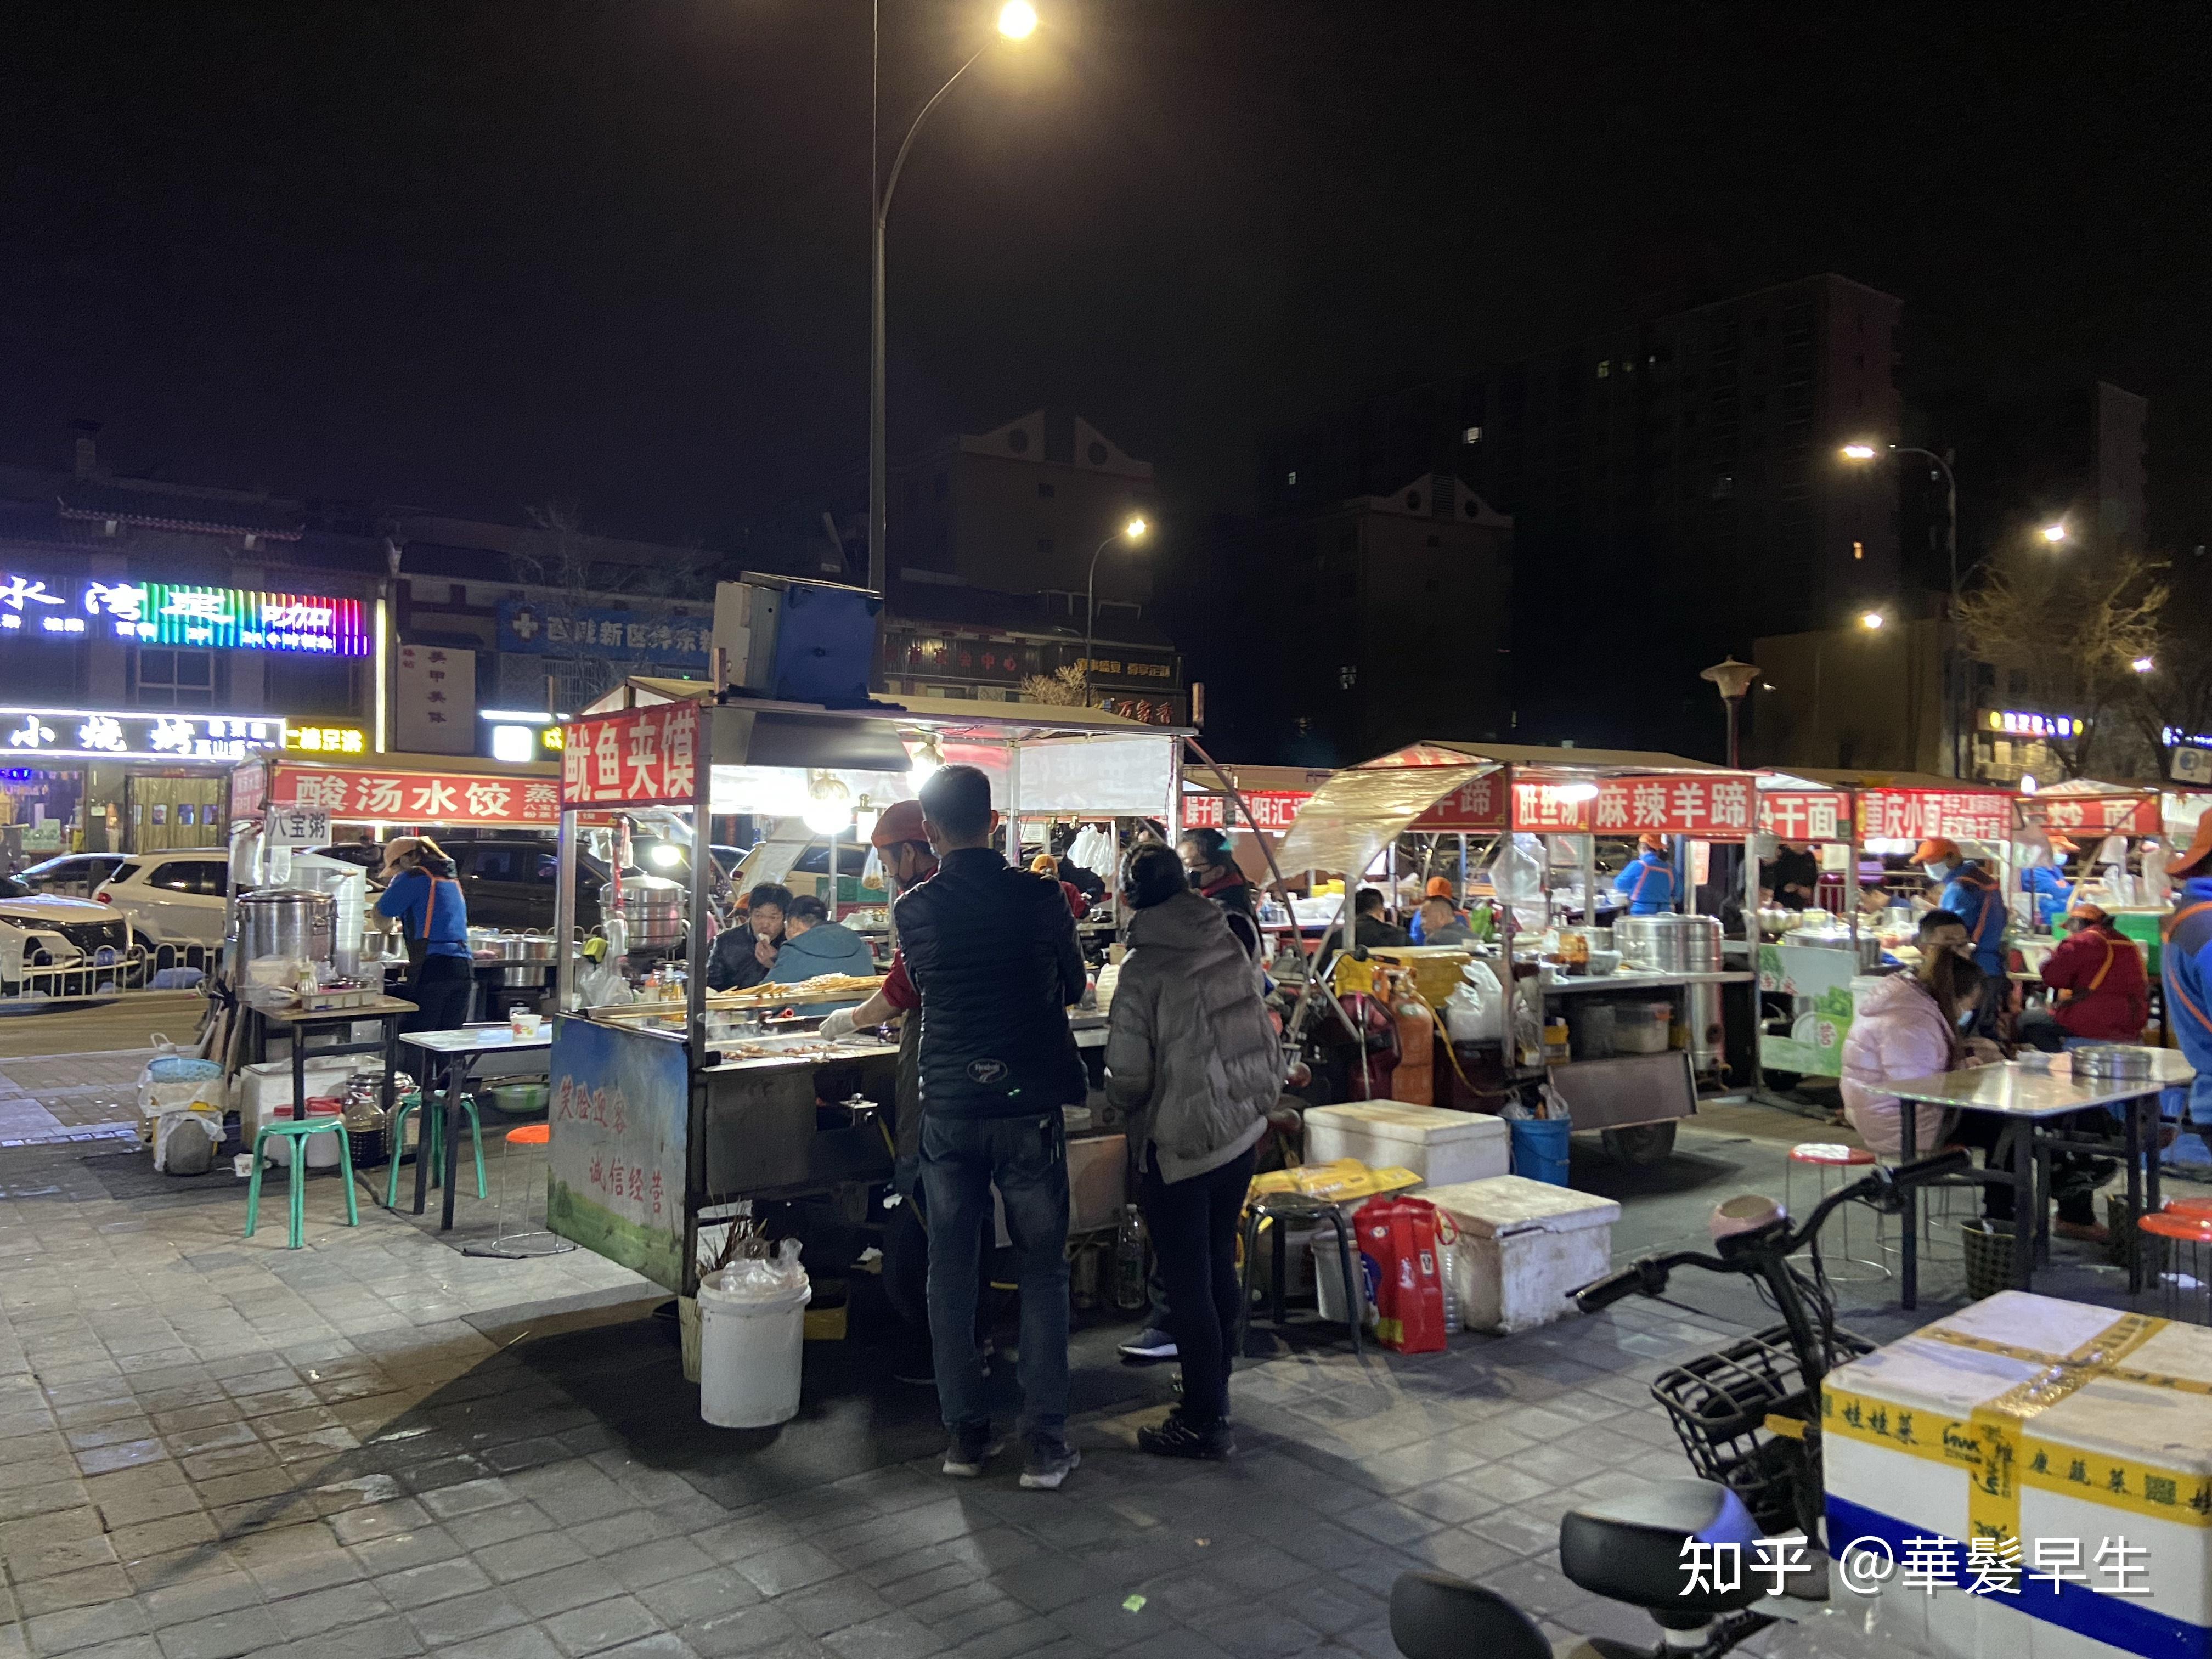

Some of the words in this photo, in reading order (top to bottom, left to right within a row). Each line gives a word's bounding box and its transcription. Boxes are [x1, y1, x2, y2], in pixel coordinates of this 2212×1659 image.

[564, 709, 695, 802] 鱿鱼夹馍
[296, 774, 511, 817] 酸汤水饺
[1596, 781, 1747, 828] 麻辣羊蹄
[1864, 792, 1943, 838] 重庆小面
[269, 810, 326, 838] 八宝粥
[557, 1075, 627, 1133] 笑脸迎客
[590, 1158, 665, 1214] 诚信经营
